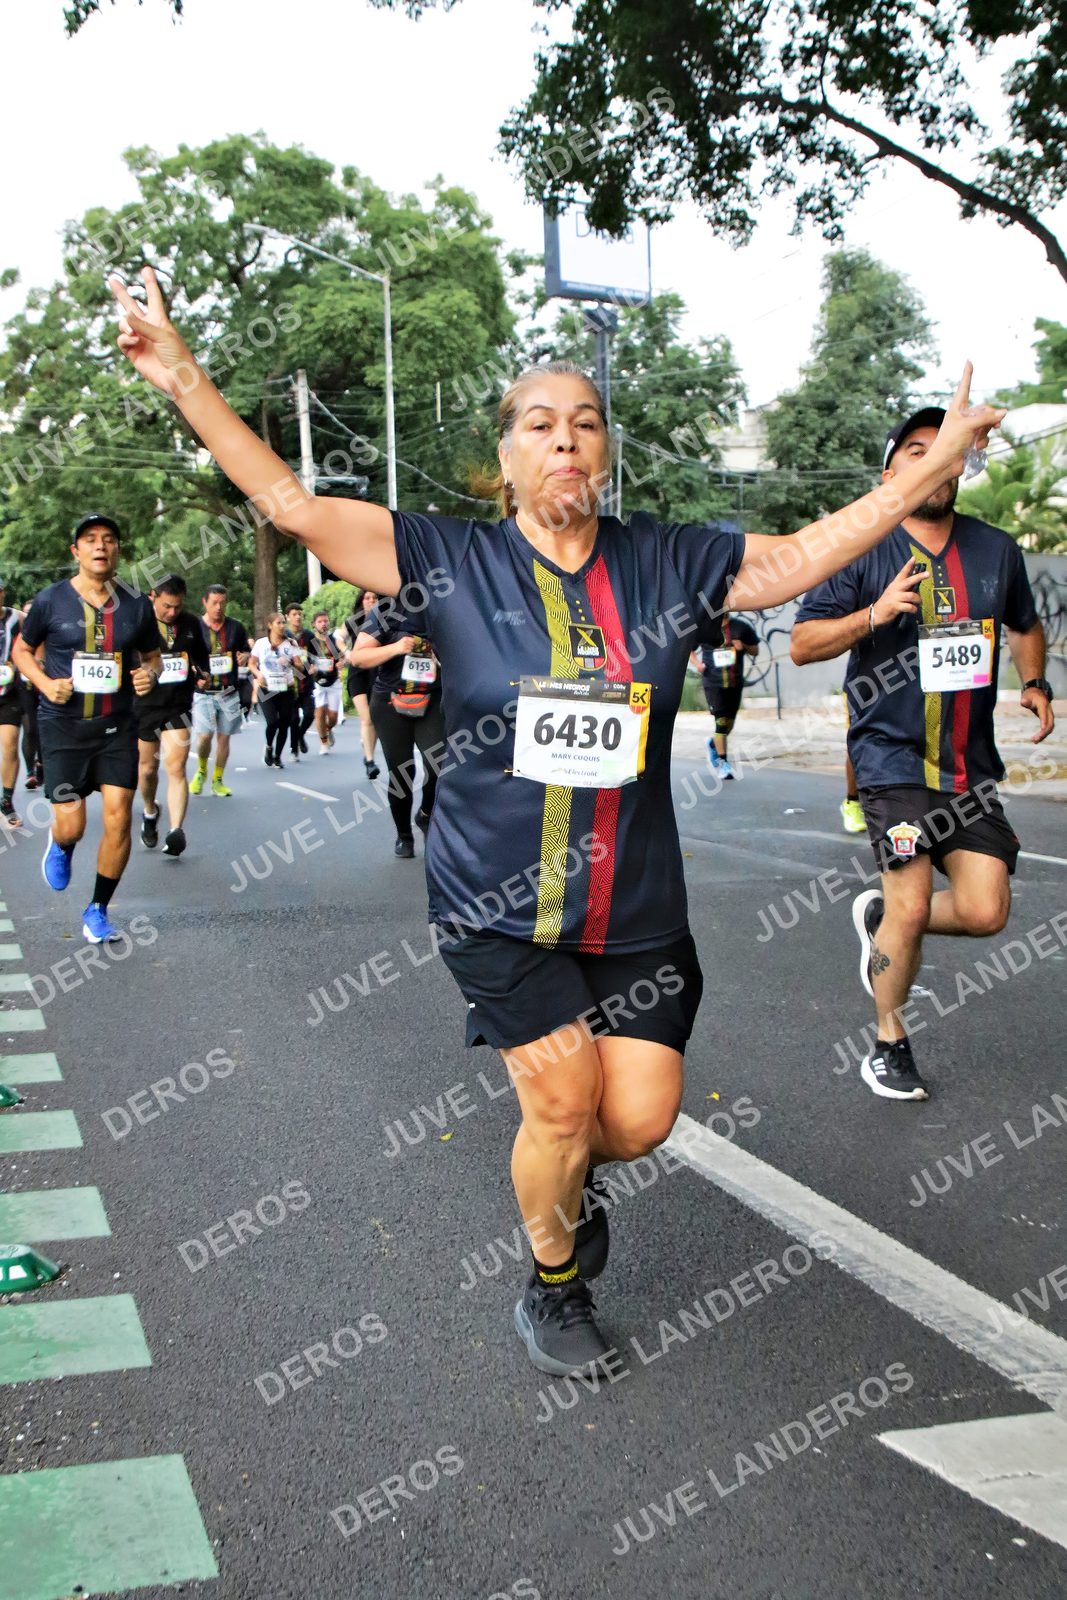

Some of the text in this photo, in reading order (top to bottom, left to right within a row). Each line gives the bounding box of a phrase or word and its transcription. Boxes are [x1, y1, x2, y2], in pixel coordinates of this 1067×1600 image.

[932, 644, 982, 668] 5489
[80, 665, 112, 678] 1462
[164, 661, 182, 672] 922
[408, 661, 430, 671] 6159
[632, 688, 648, 704] 5K
[534, 712, 622, 750] 6430
[551, 752, 600, 762] MARY CUQUIS
